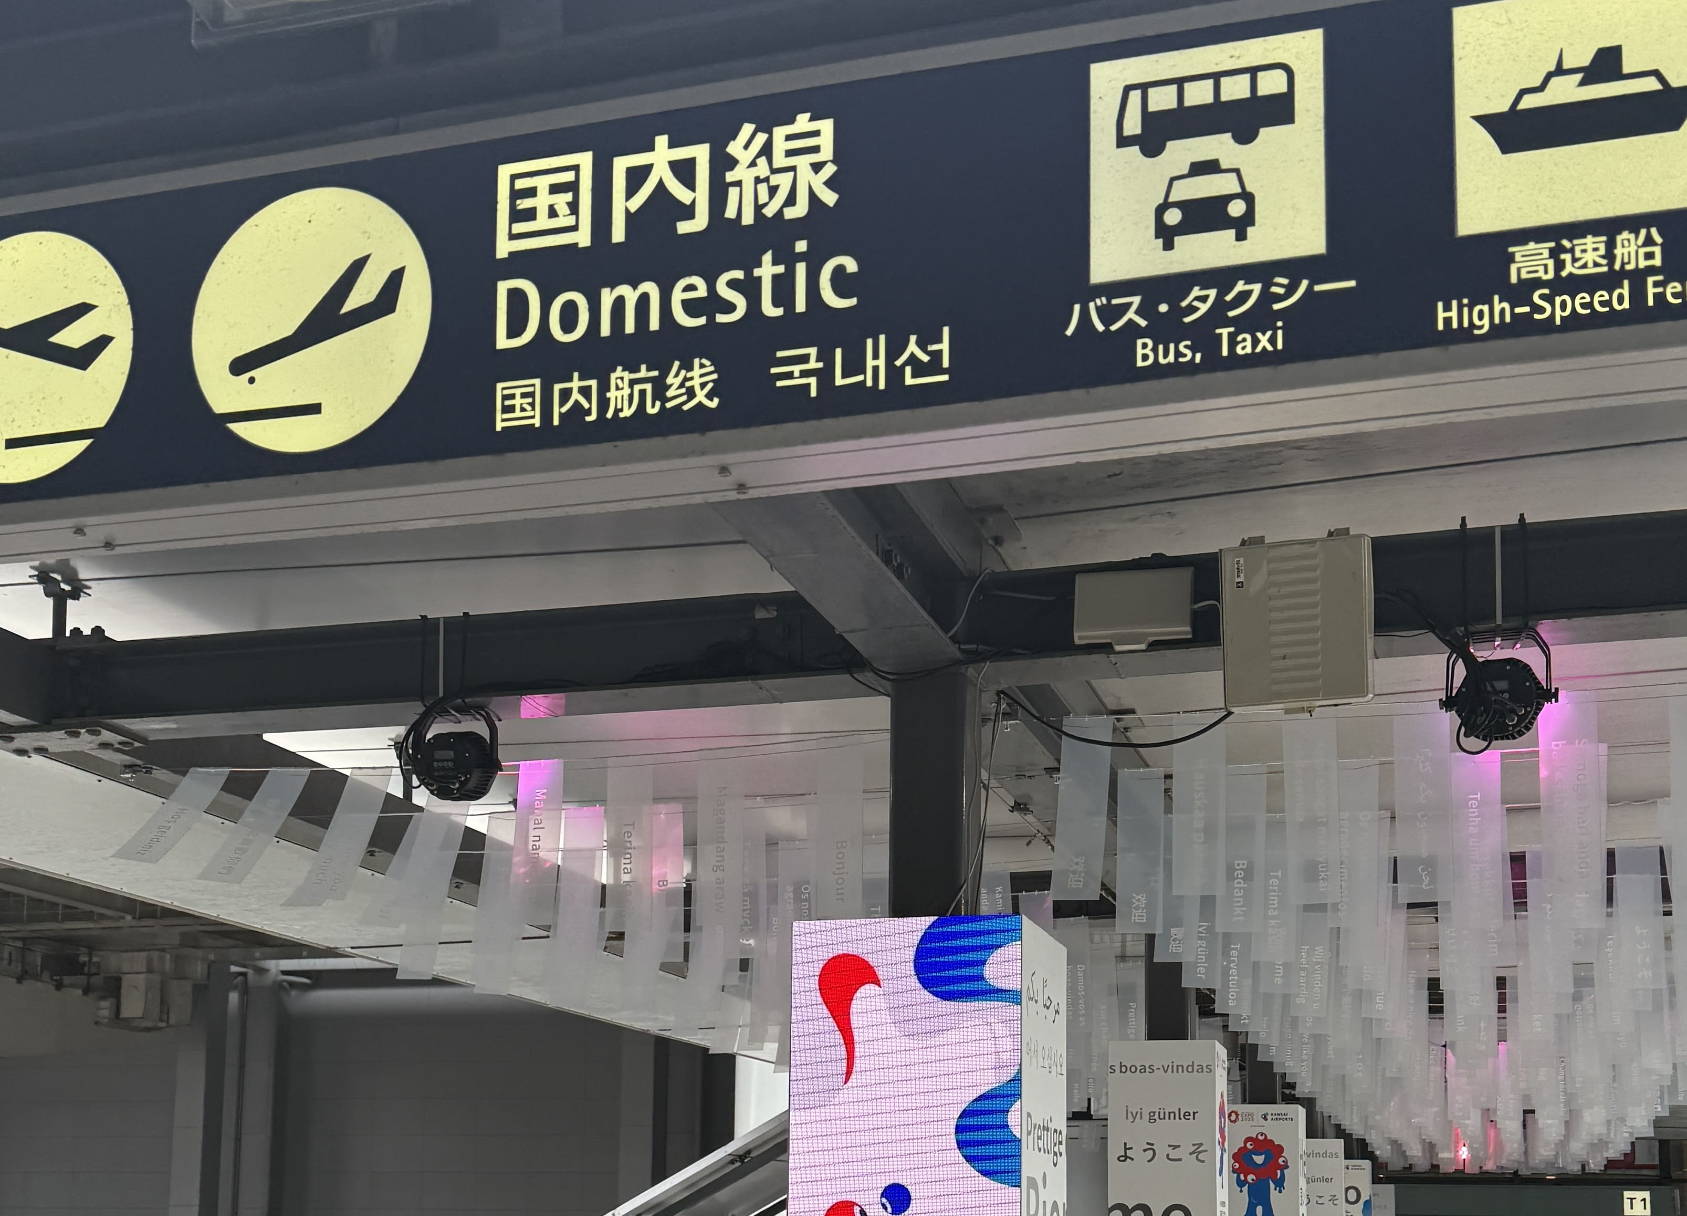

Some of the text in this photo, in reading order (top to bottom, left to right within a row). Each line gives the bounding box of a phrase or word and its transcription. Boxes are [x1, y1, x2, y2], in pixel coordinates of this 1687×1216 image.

[495, 112, 840, 259] 国内線
[1507, 226, 1664, 284] 高速船
[495, 239, 859, 350] Domestic
[1064, 276, 1357, 337] バス・タクシー
[1436, 279, 1630, 335] High-Speed
[1135, 322, 1284, 368] Bus, Taxi
[495, 326, 950, 431] 国内航线 국내선
[1467, 792, 1482, 833] Tenha
[622, 820, 638, 875] Terima
[833, 840, 848, 904] Bonjour
[1131, 893, 1148, 923] 欢迎
[1232, 860, 1249, 923] Bedankt
[1267, 869, 1282, 916] Terima
[1228, 943, 1242, 1006] Tervetuloa
[1296, 945, 1310, 1004] heel aardig
[1634, 925, 1653, 980] ようこそ
[1313, 963, 1325, 1000] vinden
[1118, 1060, 1213, 1075] boas-vindas
[1026, 1111, 1064, 1168] Prettige
[1125, 1105, 1199, 1124] İyi günler
[1116, 1141, 1209, 1164] ようこそ
